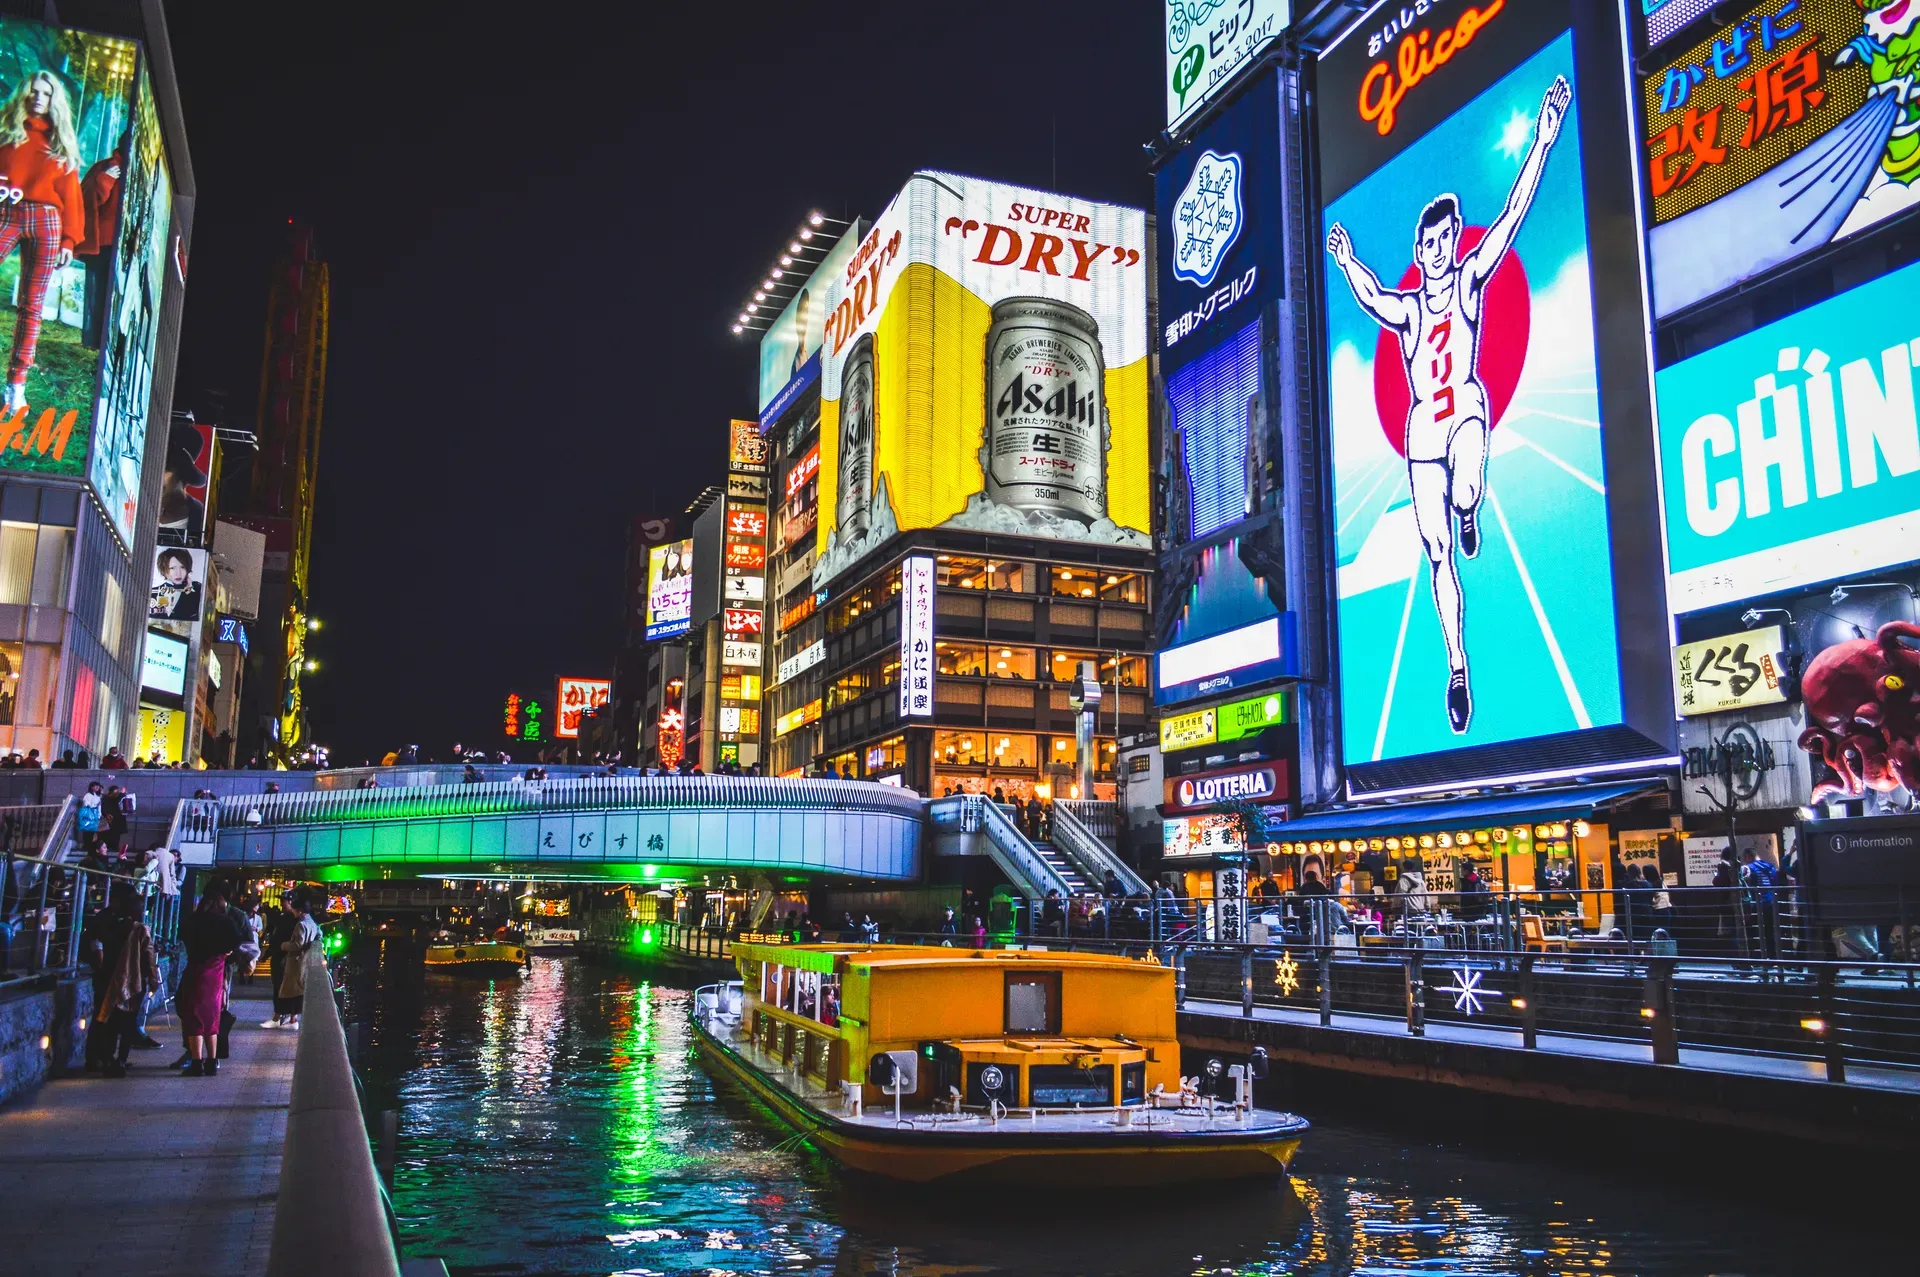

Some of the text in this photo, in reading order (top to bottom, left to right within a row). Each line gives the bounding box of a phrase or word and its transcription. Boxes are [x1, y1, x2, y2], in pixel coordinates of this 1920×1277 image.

[1367, 0, 1441, 58] おいしさ
[1208, 59, 1232, 87] Dec.
[1245, 13, 1274, 51] 2017
[1656, 0, 1804, 114] かぜに
[1359, 0, 1506, 136] Glico
[1646, 35, 1825, 198] 改源
[1008, 203, 1091, 234] SUPER
[846, 227, 880, 287] SUPER
[1165, 265, 1257, 347] 雪印メグミルク
[1008, 345, 1025, 362] ASAHI
[1026, 339, 1062, 352] BREWERIES
[1064, 348, 1085, 372] LIMITED
[1427, 311, 1455, 423] グリコ
[997, 371, 1094, 428] Asahi
[1032, 433, 1062, 455] 生
[1681, 337, 1920, 537] CHIN
[1019, 456, 1076, 472] スーパードライ
[1035, 488, 1060, 500] 350ml
[727, 567, 741, 575] 6F
[726, 612, 761, 631] はや
[724, 633, 738, 641] 4F
[726, 645, 757, 660] 白木屋
[914, 638, 929, 709] かに道楽
[1694, 642, 1762, 697] くくる
[565, 684, 609, 709] かに
[1717, 699, 1742, 707] KUKURU
[1236, 702, 1264, 727] ピタットハウス
[721, 733, 735, 741] 1F
[1196, 771, 1266, 801] LOTTERIA
[542, 831, 664, 852] えびす橋
[1849, 835, 1913, 848] information
